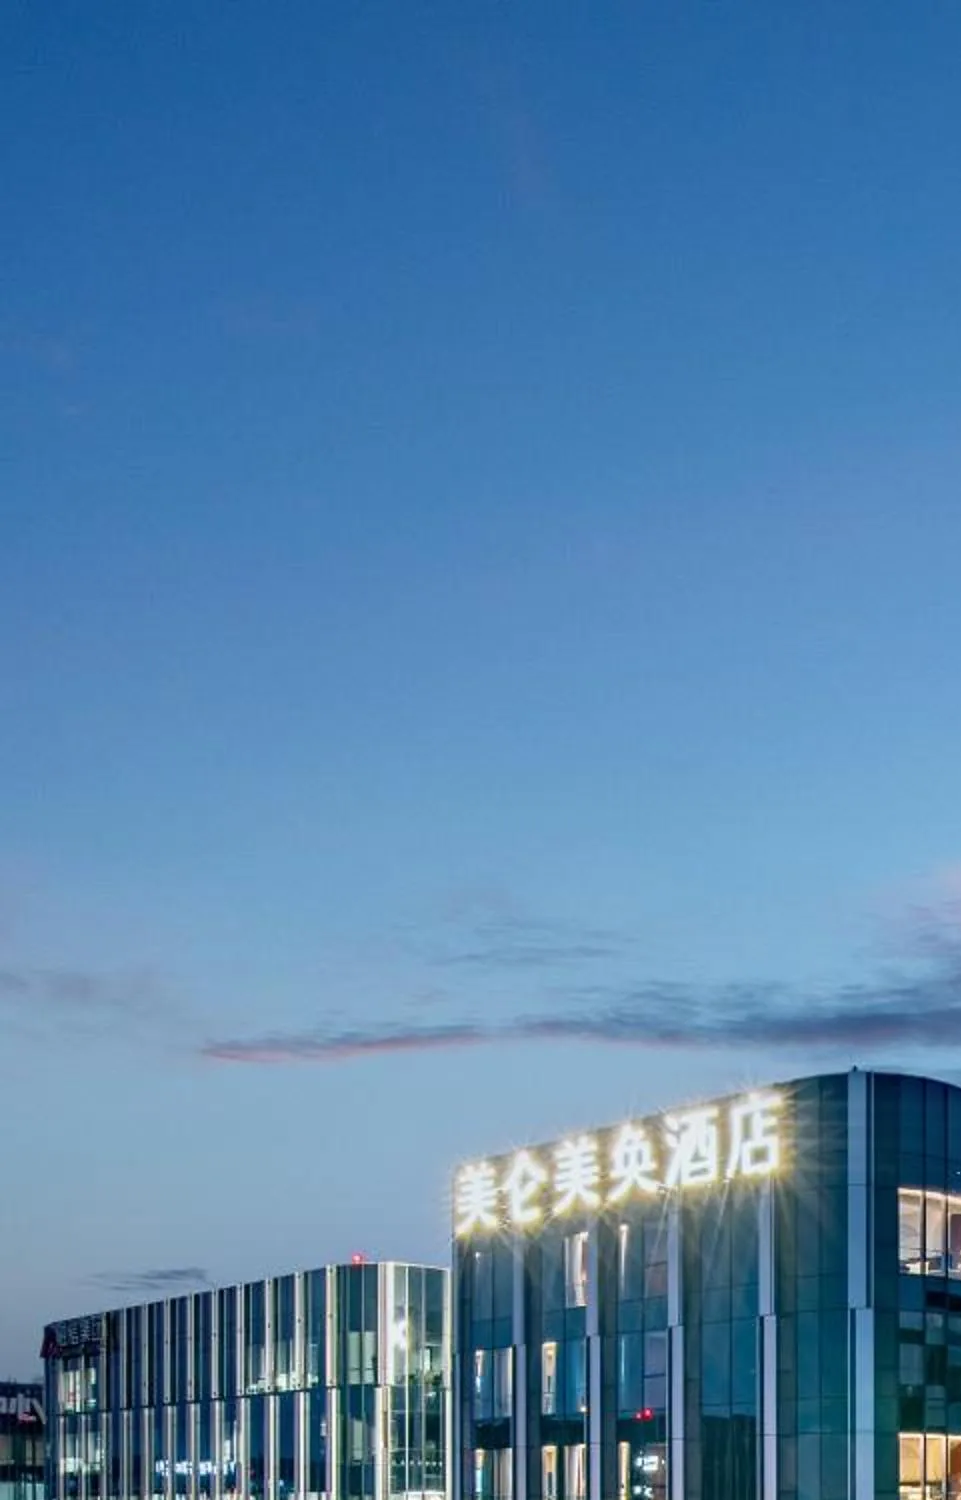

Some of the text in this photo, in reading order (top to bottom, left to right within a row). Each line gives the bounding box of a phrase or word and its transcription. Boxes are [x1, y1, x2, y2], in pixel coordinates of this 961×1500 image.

[455, 1092, 781, 1237] 美仑美奂酒店
